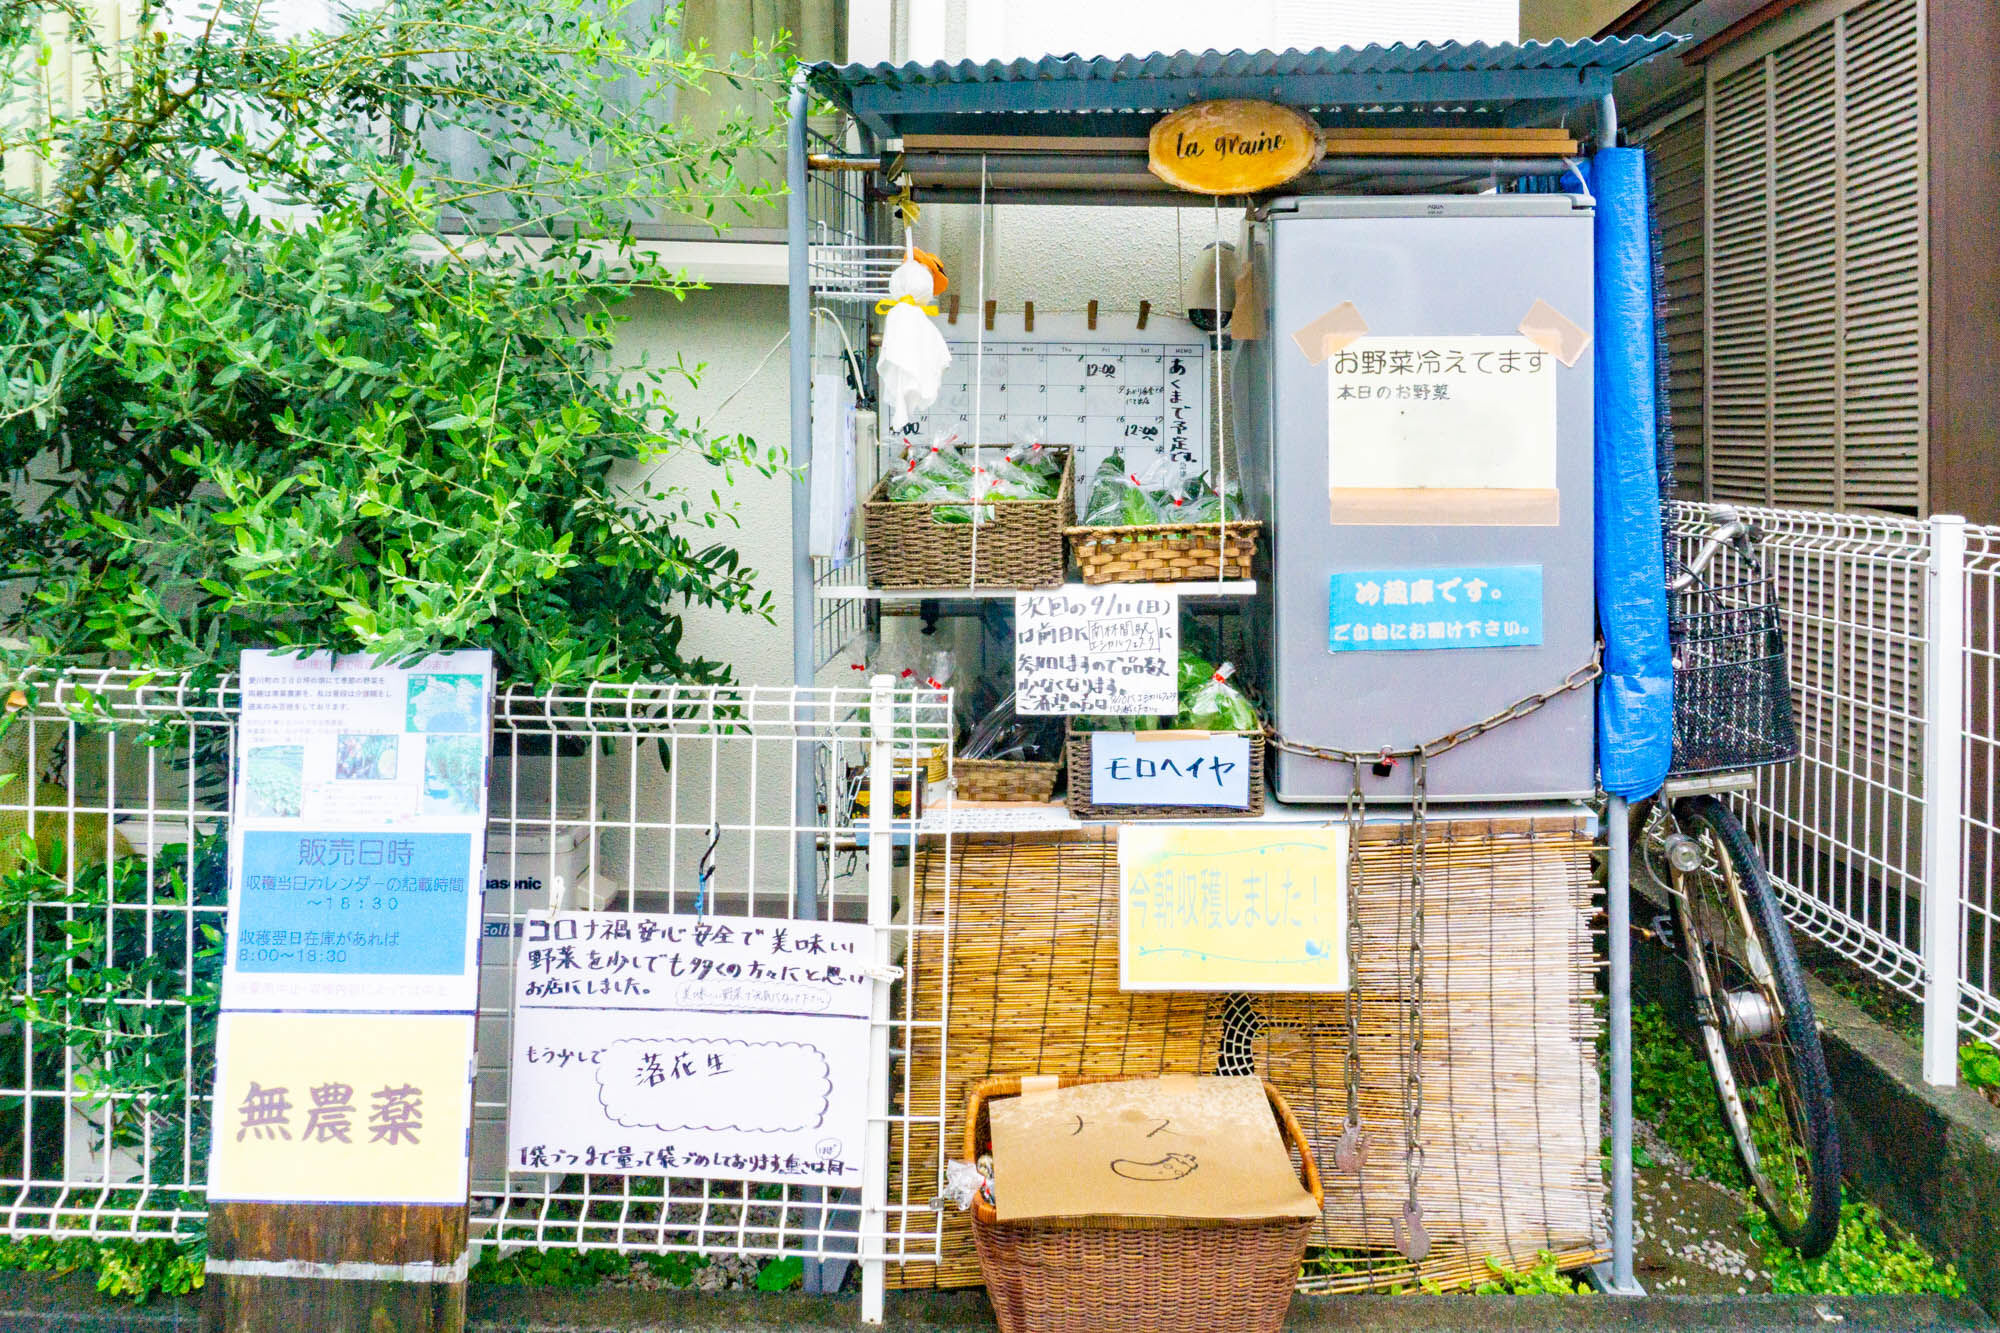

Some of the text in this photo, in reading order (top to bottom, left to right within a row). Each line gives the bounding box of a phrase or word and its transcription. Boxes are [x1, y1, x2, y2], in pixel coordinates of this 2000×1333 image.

[1176, 131, 1284, 161] la graine
[1334, 349, 1549, 375] お野菜冷えてます
[1336, 383, 1451, 401] 本日のお野菜
[1017, 653, 1171, 678] 参加しますので品数
[1104, 755, 1236, 787] モロヘイヤ
[297, 838, 416, 868] 販売日時
[246, 875, 465, 893] 収穫当日カレンダーの記載時間
[240, 929, 400, 947] 収穫翌日在庫があれば
[528, 918, 855, 956] コロナ禍安心安全で美味しい
[527, 944, 864, 986] 野菜を少しでも多くの方々にと思い
[525, 976, 651, 999] お店にしました。
[527, 1045, 609, 1068] もう少しで
[634, 1050, 735, 1088] 落花生
[235, 1080, 423, 1146] 無農薬
